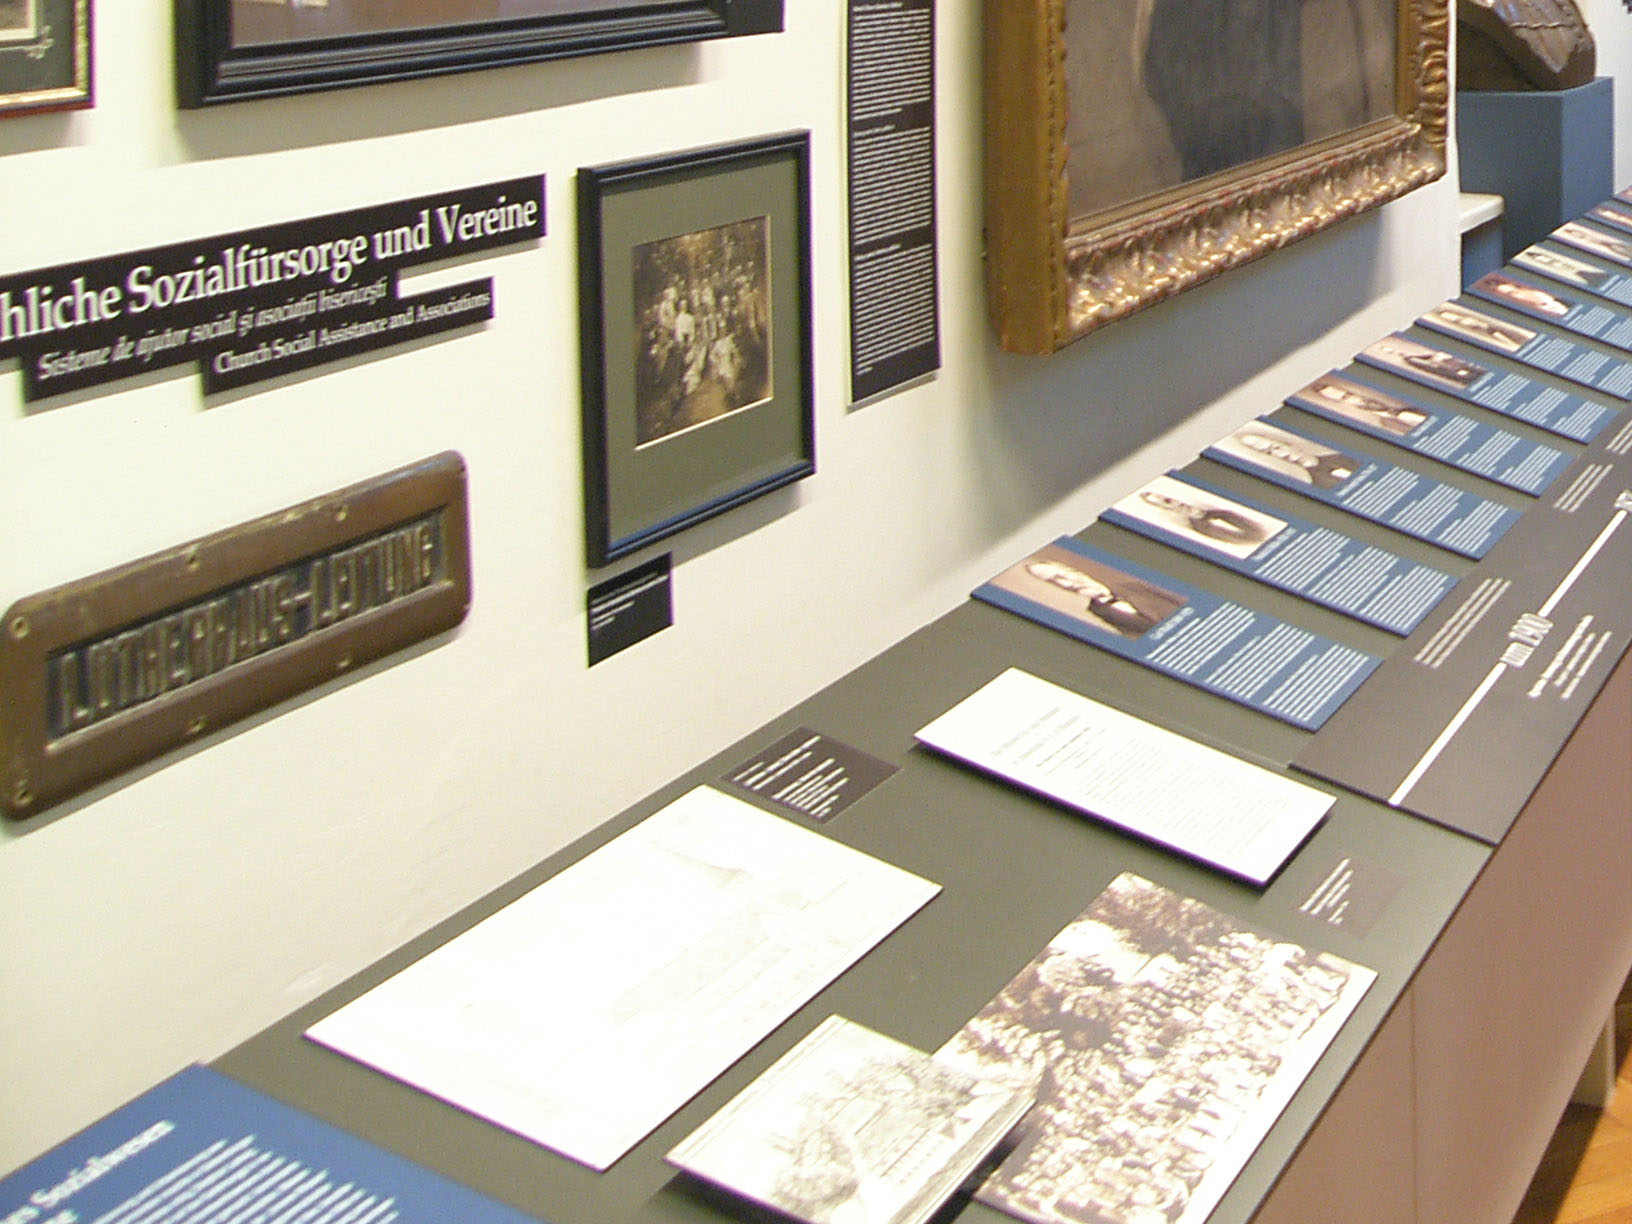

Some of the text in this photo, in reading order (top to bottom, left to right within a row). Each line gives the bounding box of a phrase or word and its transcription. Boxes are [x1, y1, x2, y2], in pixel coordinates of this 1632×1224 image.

[0, 196, 538, 342] hliche Sozialfürsorge und Vereine
[112, 335, 136, 361] de
[213, 291, 491, 373] Church Social Assistance and Associations
